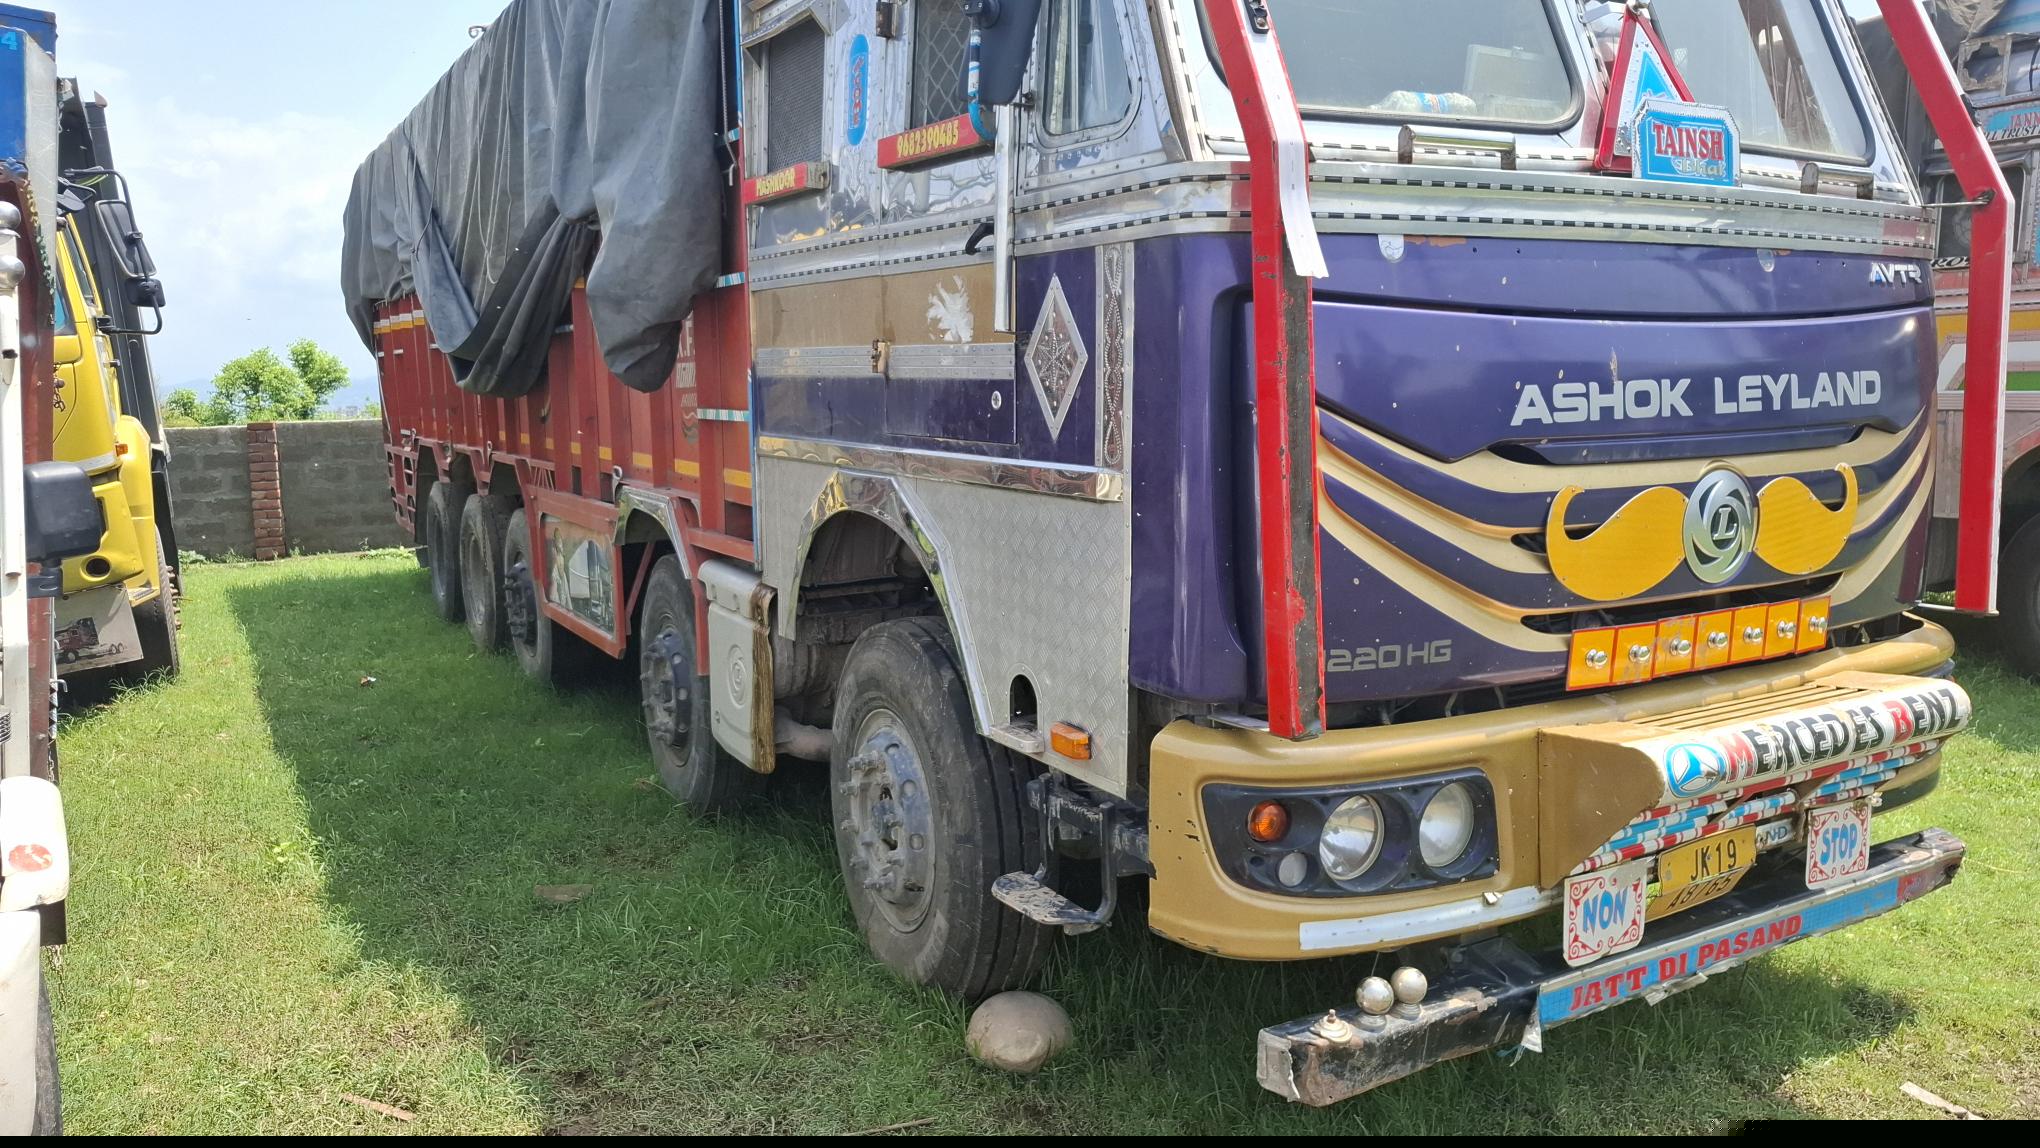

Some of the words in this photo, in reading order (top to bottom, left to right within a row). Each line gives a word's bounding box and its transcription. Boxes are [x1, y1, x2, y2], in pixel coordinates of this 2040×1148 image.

[1652, 123, 1724, 160] TAINSH
[1869, 262, 1923, 284] AVTR
[1510, 377, 1694, 427] ASHOK
[1714, 370, 1882, 415] LEYLAND
[1323, 644, 1401, 673] 220
[1406, 639, 1453, 666] HG
[1716, 705, 1886, 785] MERCEDES
[1882, 688, 1966, 745] BENZ
[1690, 839, 1737, 882] JK19
[1820, 823, 1858, 865] STOP
[1582, 886, 1629, 936] NON
[1570, 966, 1647, 1011] JATT
[1658, 952, 1688, 982] DI
[1697, 914, 1803, 967] PASAND
